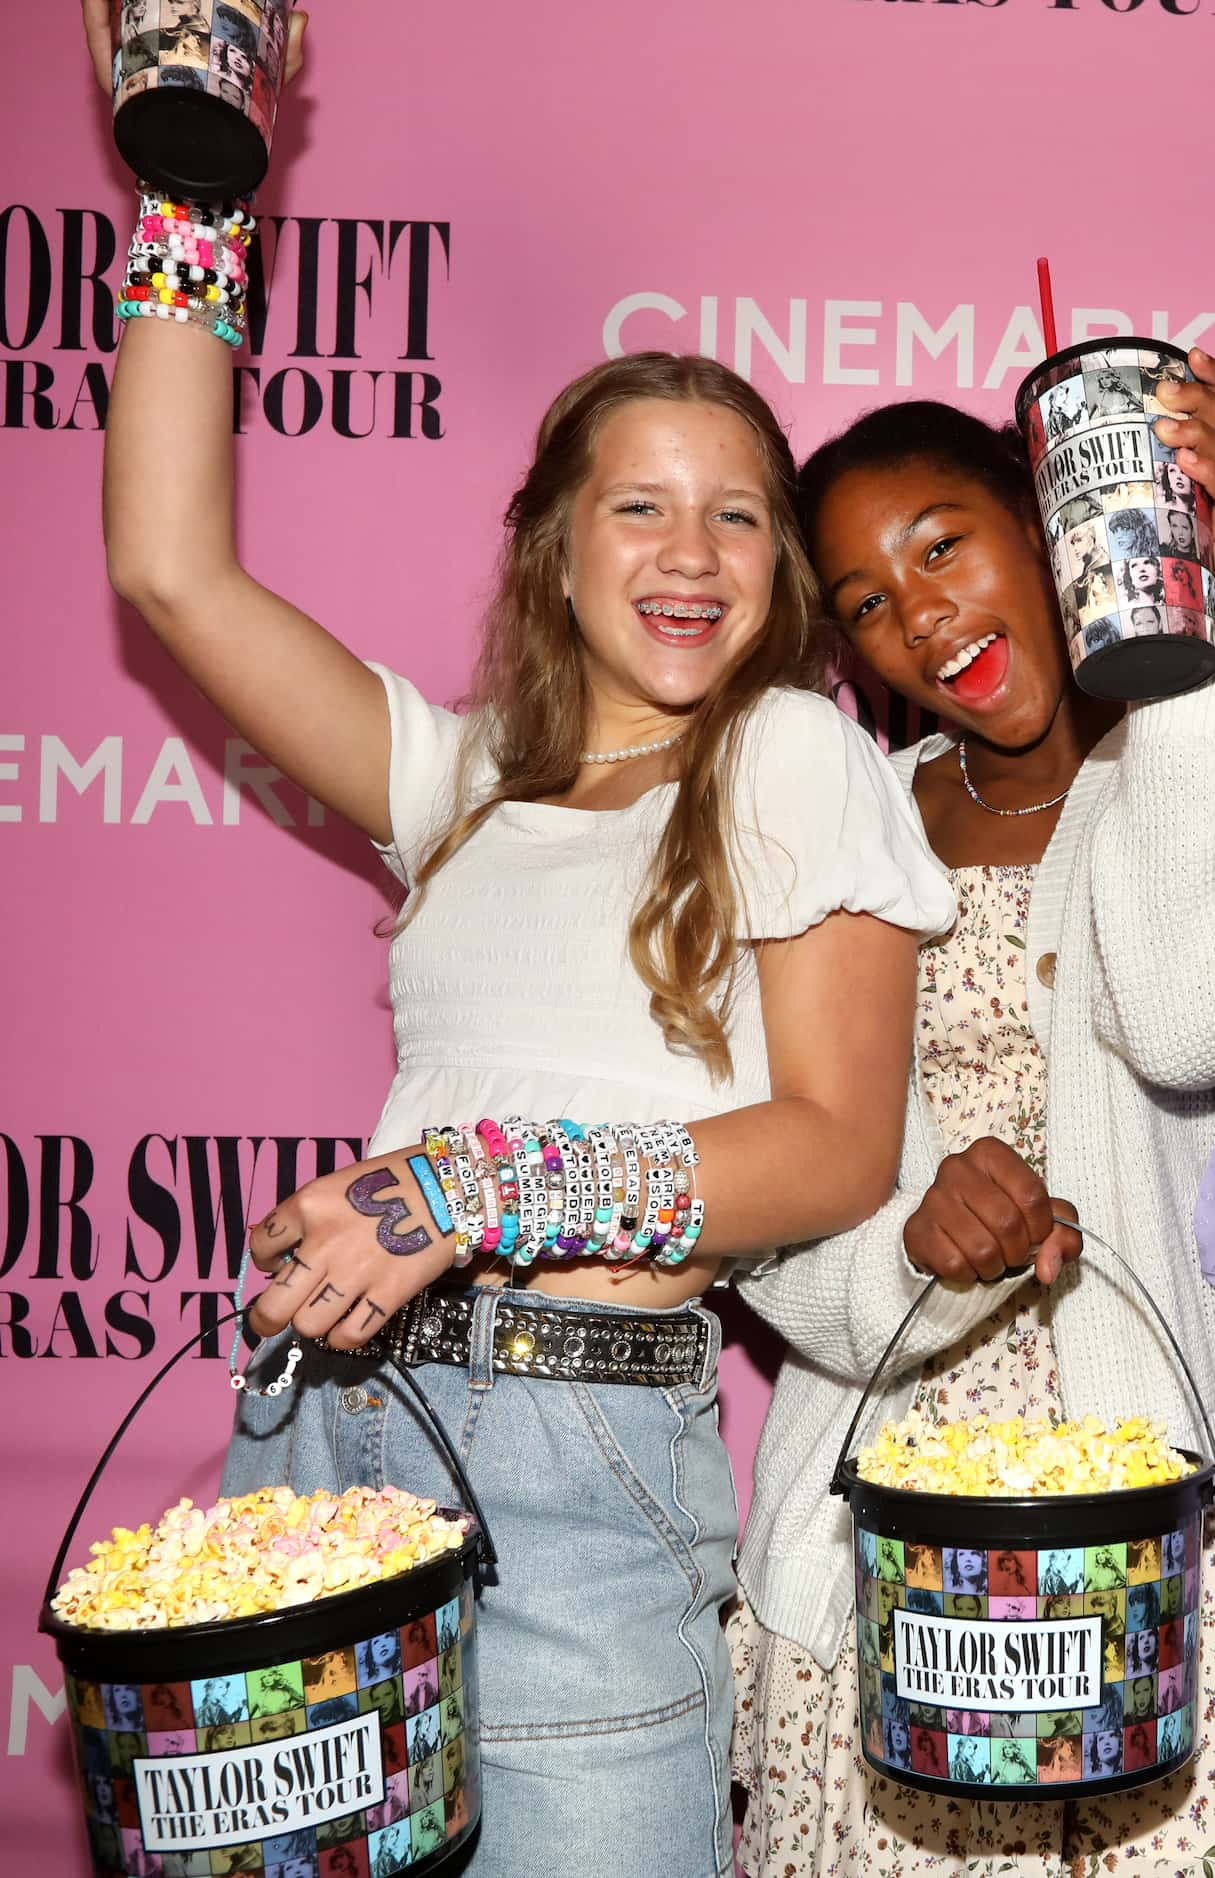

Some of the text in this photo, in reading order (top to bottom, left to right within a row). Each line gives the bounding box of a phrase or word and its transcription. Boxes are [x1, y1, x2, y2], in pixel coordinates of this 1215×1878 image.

[1079, 430, 1142, 469] SWIFT
[1093, 460, 1145, 480] TOUR
[457, 1155, 479, 1195] FOR
[515, 1151, 533, 1234] SUMMER
[624, 1149, 638, 1204] ERAS
[901, 1621, 1092, 1677] TAYLOR SWIFT
[903, 1666, 1090, 1700] THE ERAS TOUR
[144, 1726, 371, 1815] TAYLOR SWIFT
[151, 1773, 373, 1840] THE ERAS TOUR
